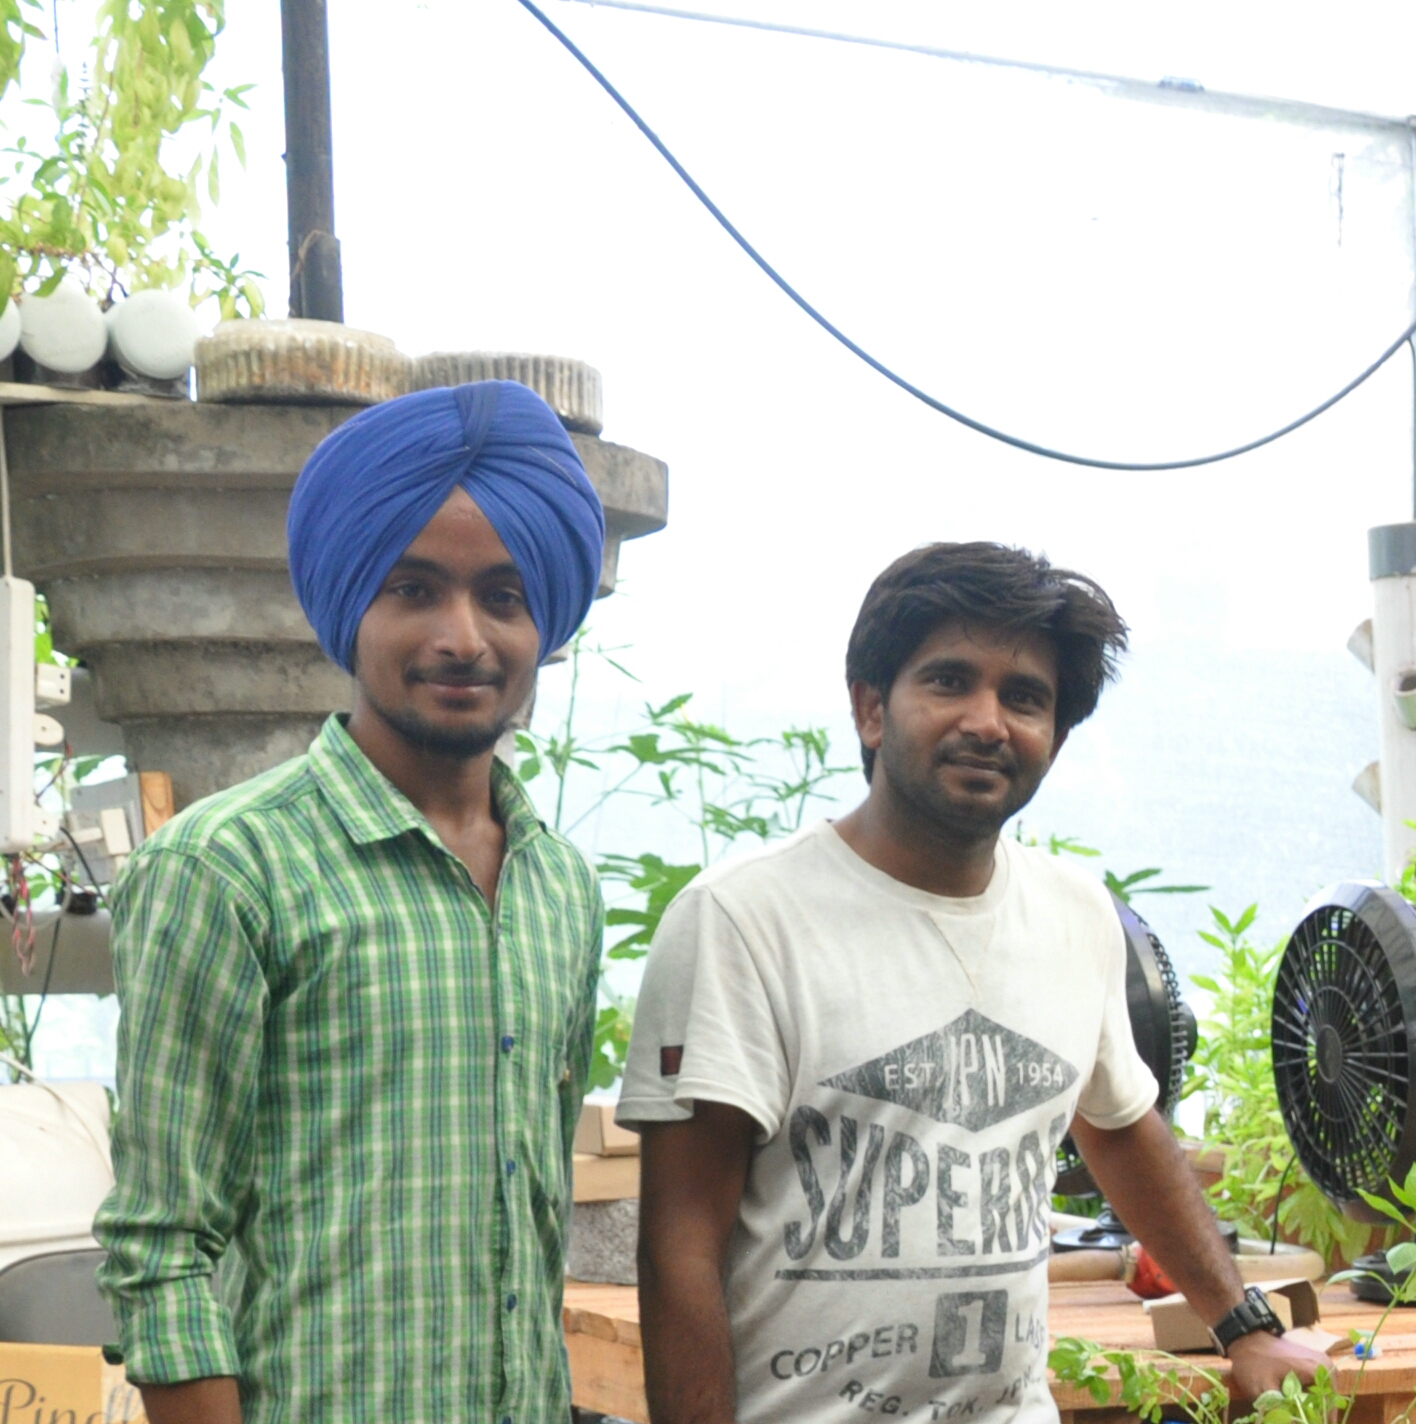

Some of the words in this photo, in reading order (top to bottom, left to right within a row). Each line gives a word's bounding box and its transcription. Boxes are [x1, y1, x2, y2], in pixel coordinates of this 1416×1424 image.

[1016, 1061, 1065, 1088] 1954
[769, 1321, 920, 1381] COPPER
[839, 1378, 910, 1418] REG.
